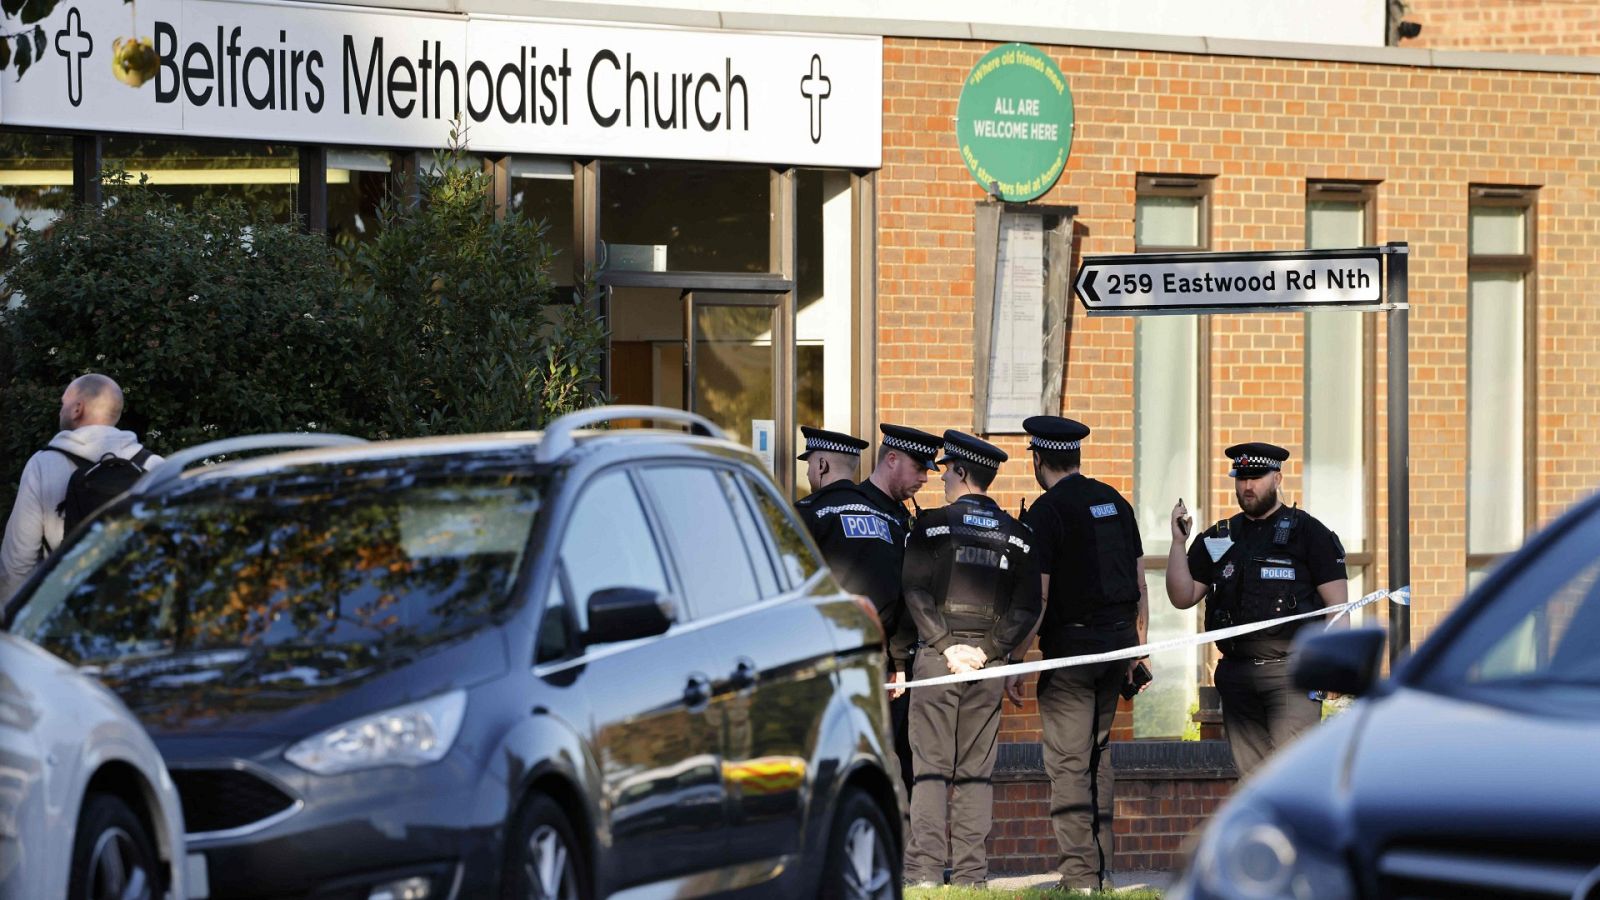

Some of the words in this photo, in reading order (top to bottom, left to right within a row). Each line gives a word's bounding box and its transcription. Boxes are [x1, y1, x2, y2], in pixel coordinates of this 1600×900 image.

[1001, 51, 1015, 65] old
[1016, 51, 1044, 72] friends
[154, 20, 326, 114] Belfairs
[342, 34, 573, 127] Methodist
[587, 48, 750, 132] Church
[994, 97, 1015, 115] ALL
[1017, 99, 1040, 116] ARE
[973, 120, 1028, 139] WELCOME
[1030, 124, 1058, 141] HERE
[1016, 179, 1031, 196] feel
[1032, 176, 1042, 192] at
[1107, 273, 1153, 295] 259
[1163, 271, 1276, 294] Eastwood
[1286, 270, 1316, 290] Rd
[1327, 268, 1370, 289] Nth
[1090, 503, 1116, 516] POLICE
[846, 517, 888, 539] POLICE
[966, 515, 998, 528] POLICE
[1263, 568, 1295, 579] POLICE
